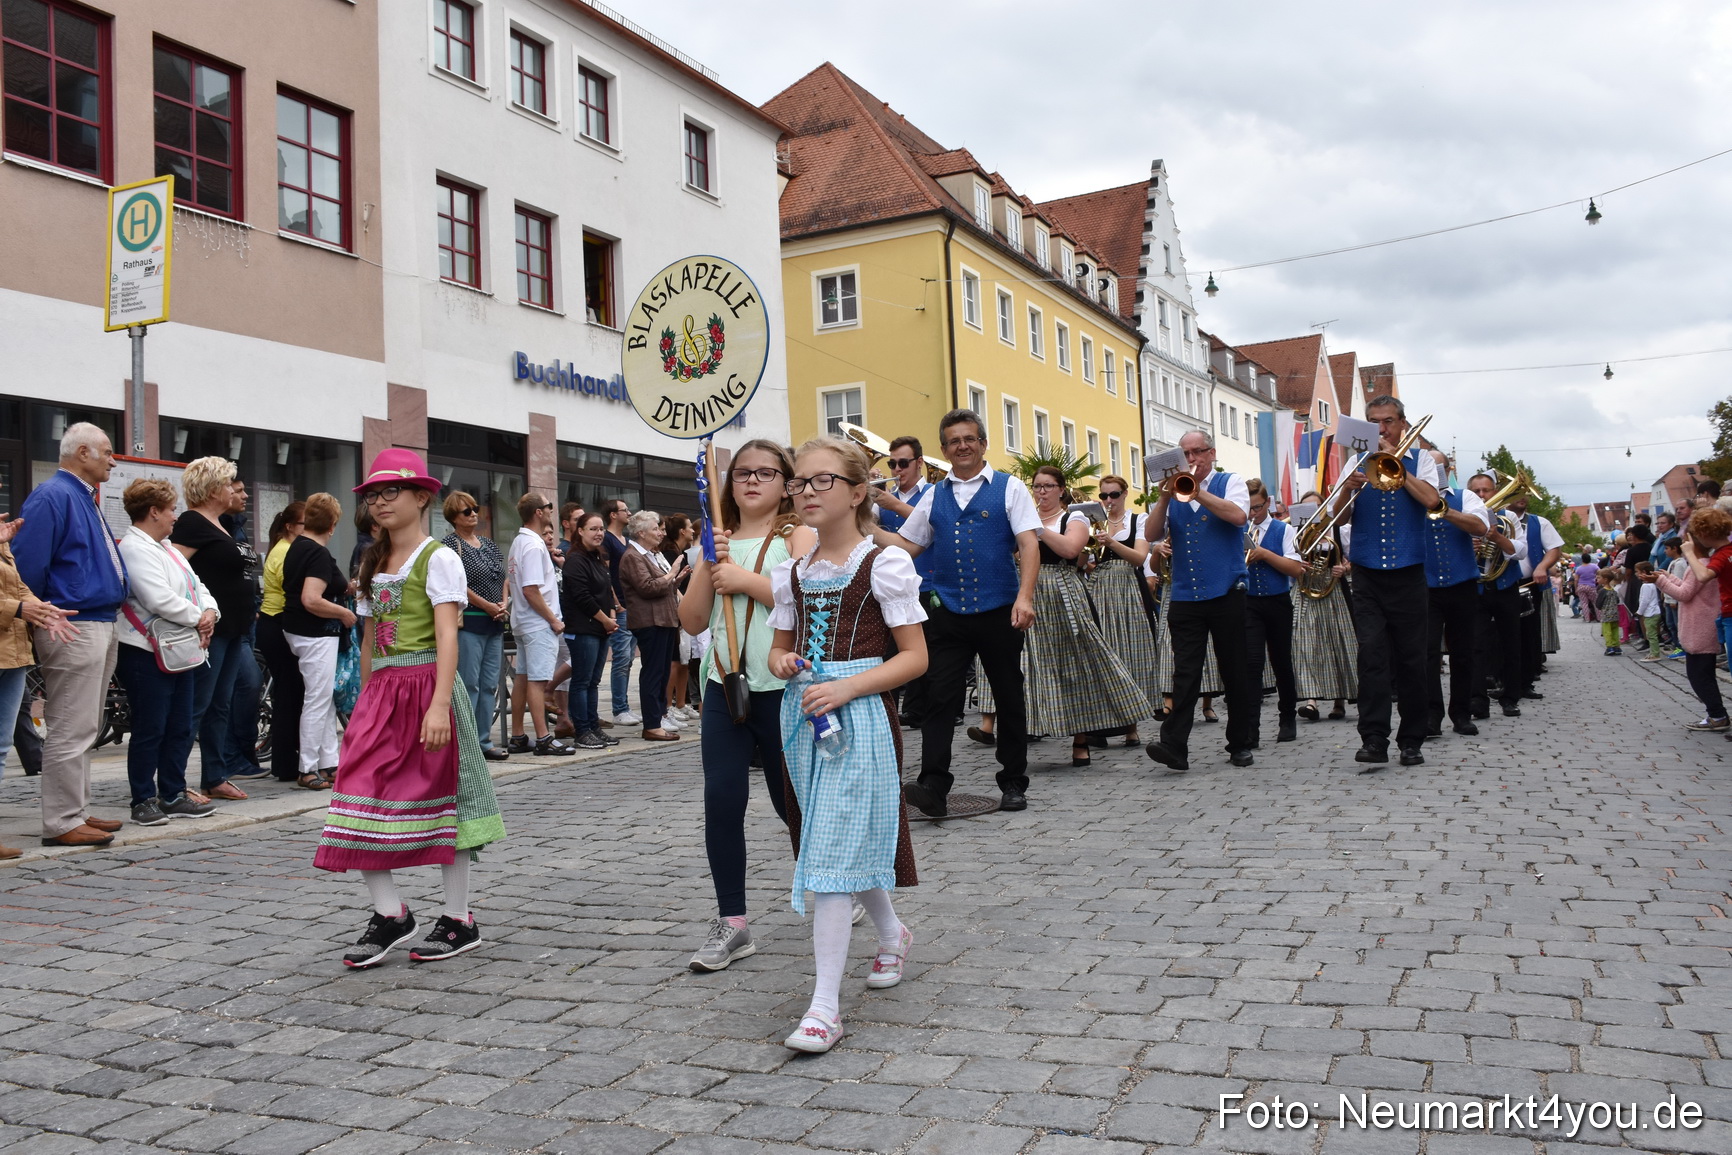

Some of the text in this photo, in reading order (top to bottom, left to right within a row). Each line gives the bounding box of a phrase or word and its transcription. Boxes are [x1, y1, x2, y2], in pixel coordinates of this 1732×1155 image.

[130, 204, 149, 240] H
[122, 258, 153, 270] Rathaus
[628, 262, 756, 353] BLASKAPELLE
[513, 350, 631, 405] Buchhandl
[651, 373, 747, 432] DEINING
